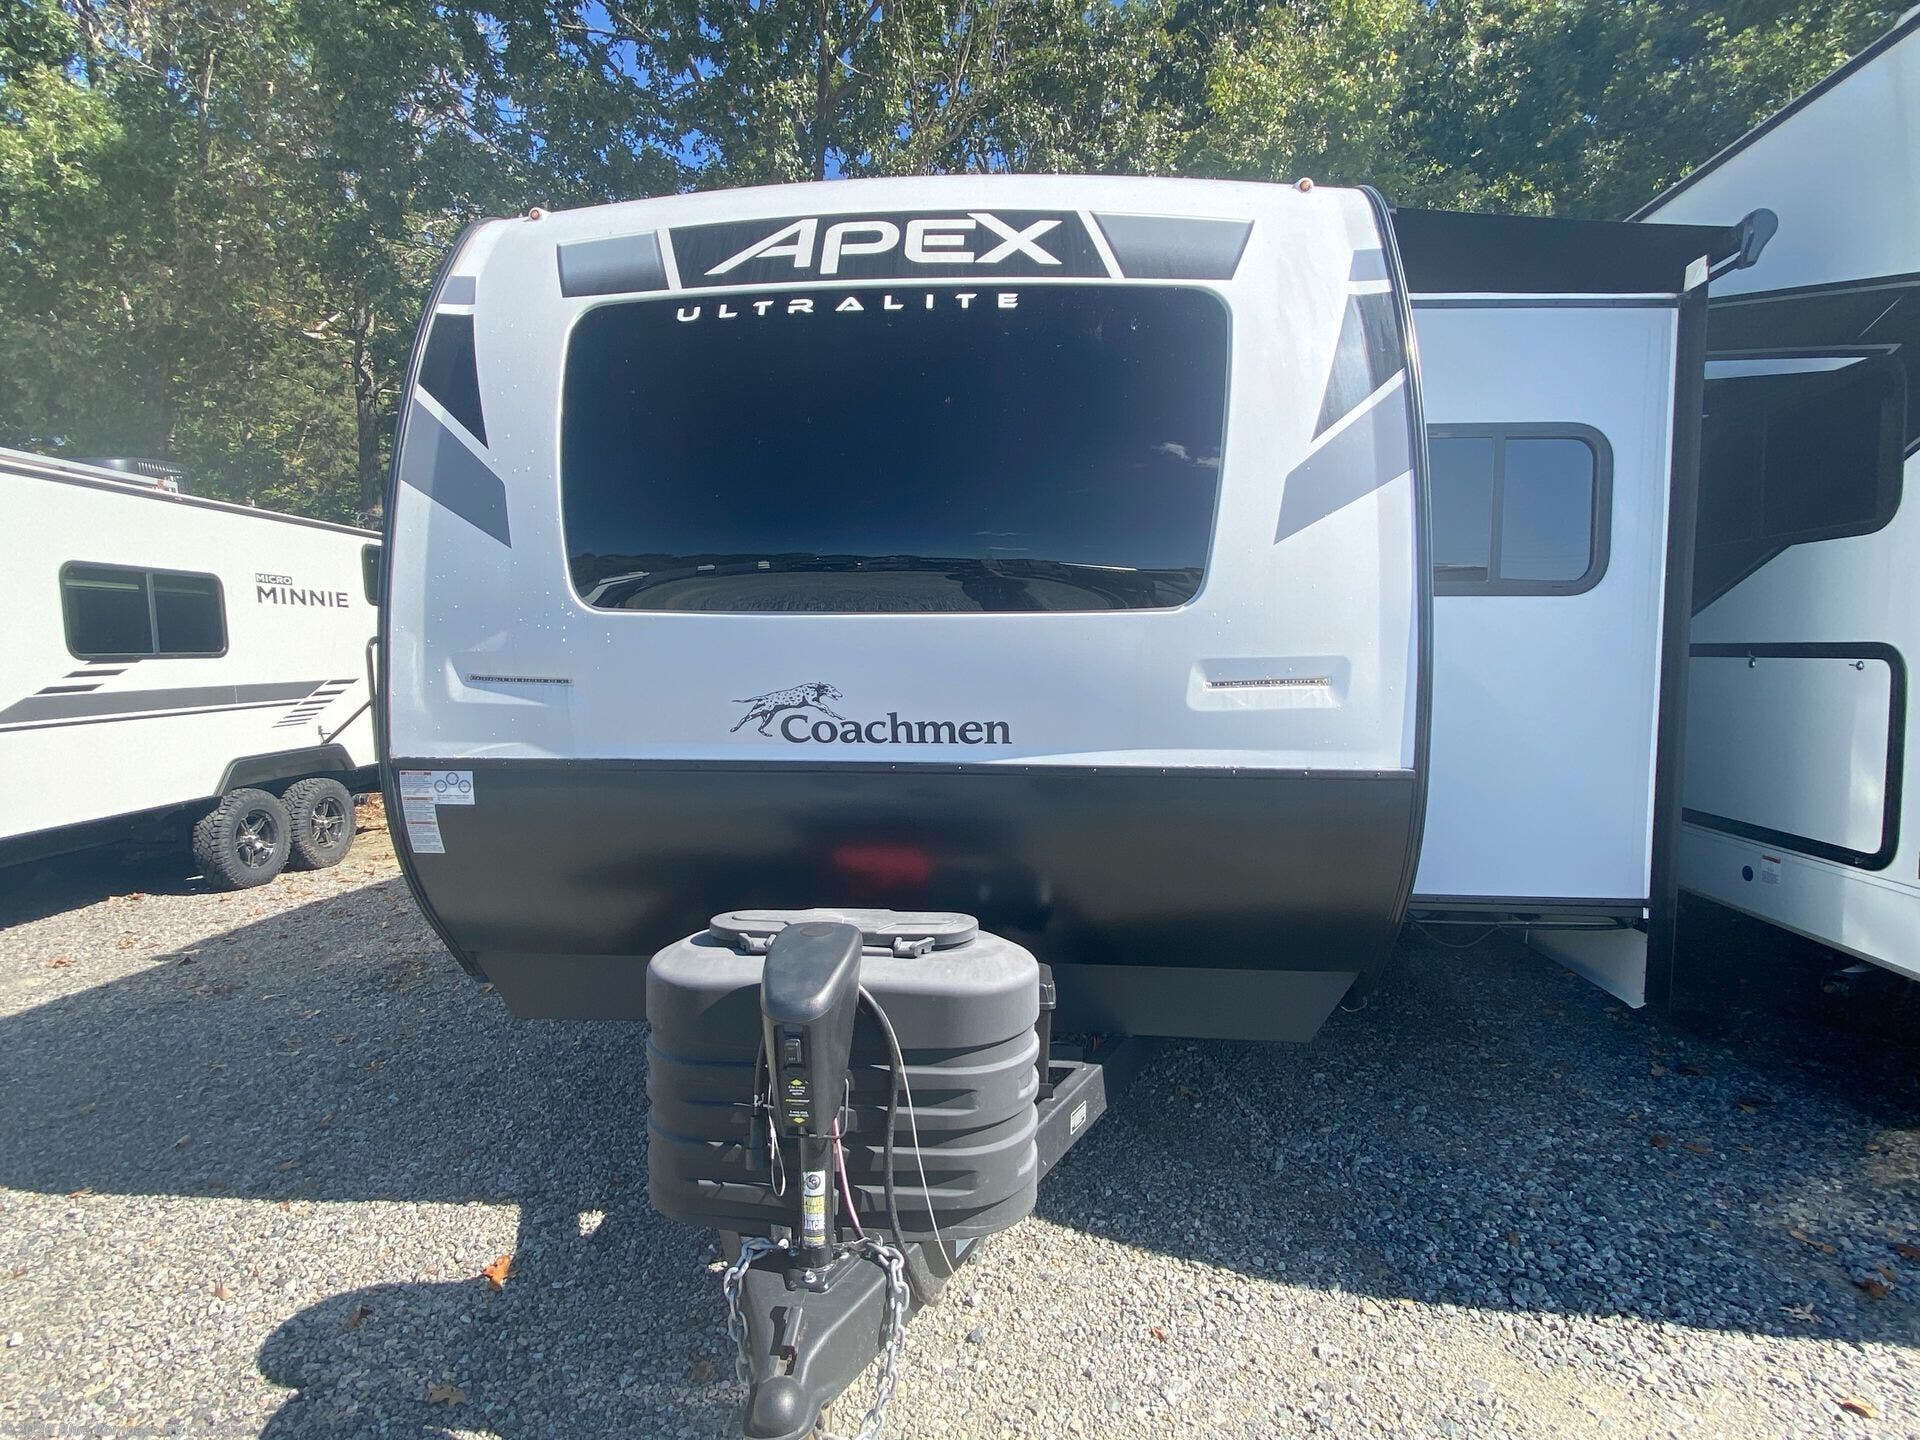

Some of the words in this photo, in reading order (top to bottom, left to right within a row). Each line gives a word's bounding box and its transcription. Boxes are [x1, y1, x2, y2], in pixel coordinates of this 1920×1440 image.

[704, 212, 1063, 275] APEX
[677, 293, 1019, 322] ULTRALITE
[255, 574, 292, 585] MICRO
[257, 586, 349, 608] MINNIE
[780, 712, 1013, 745] Coachmen
